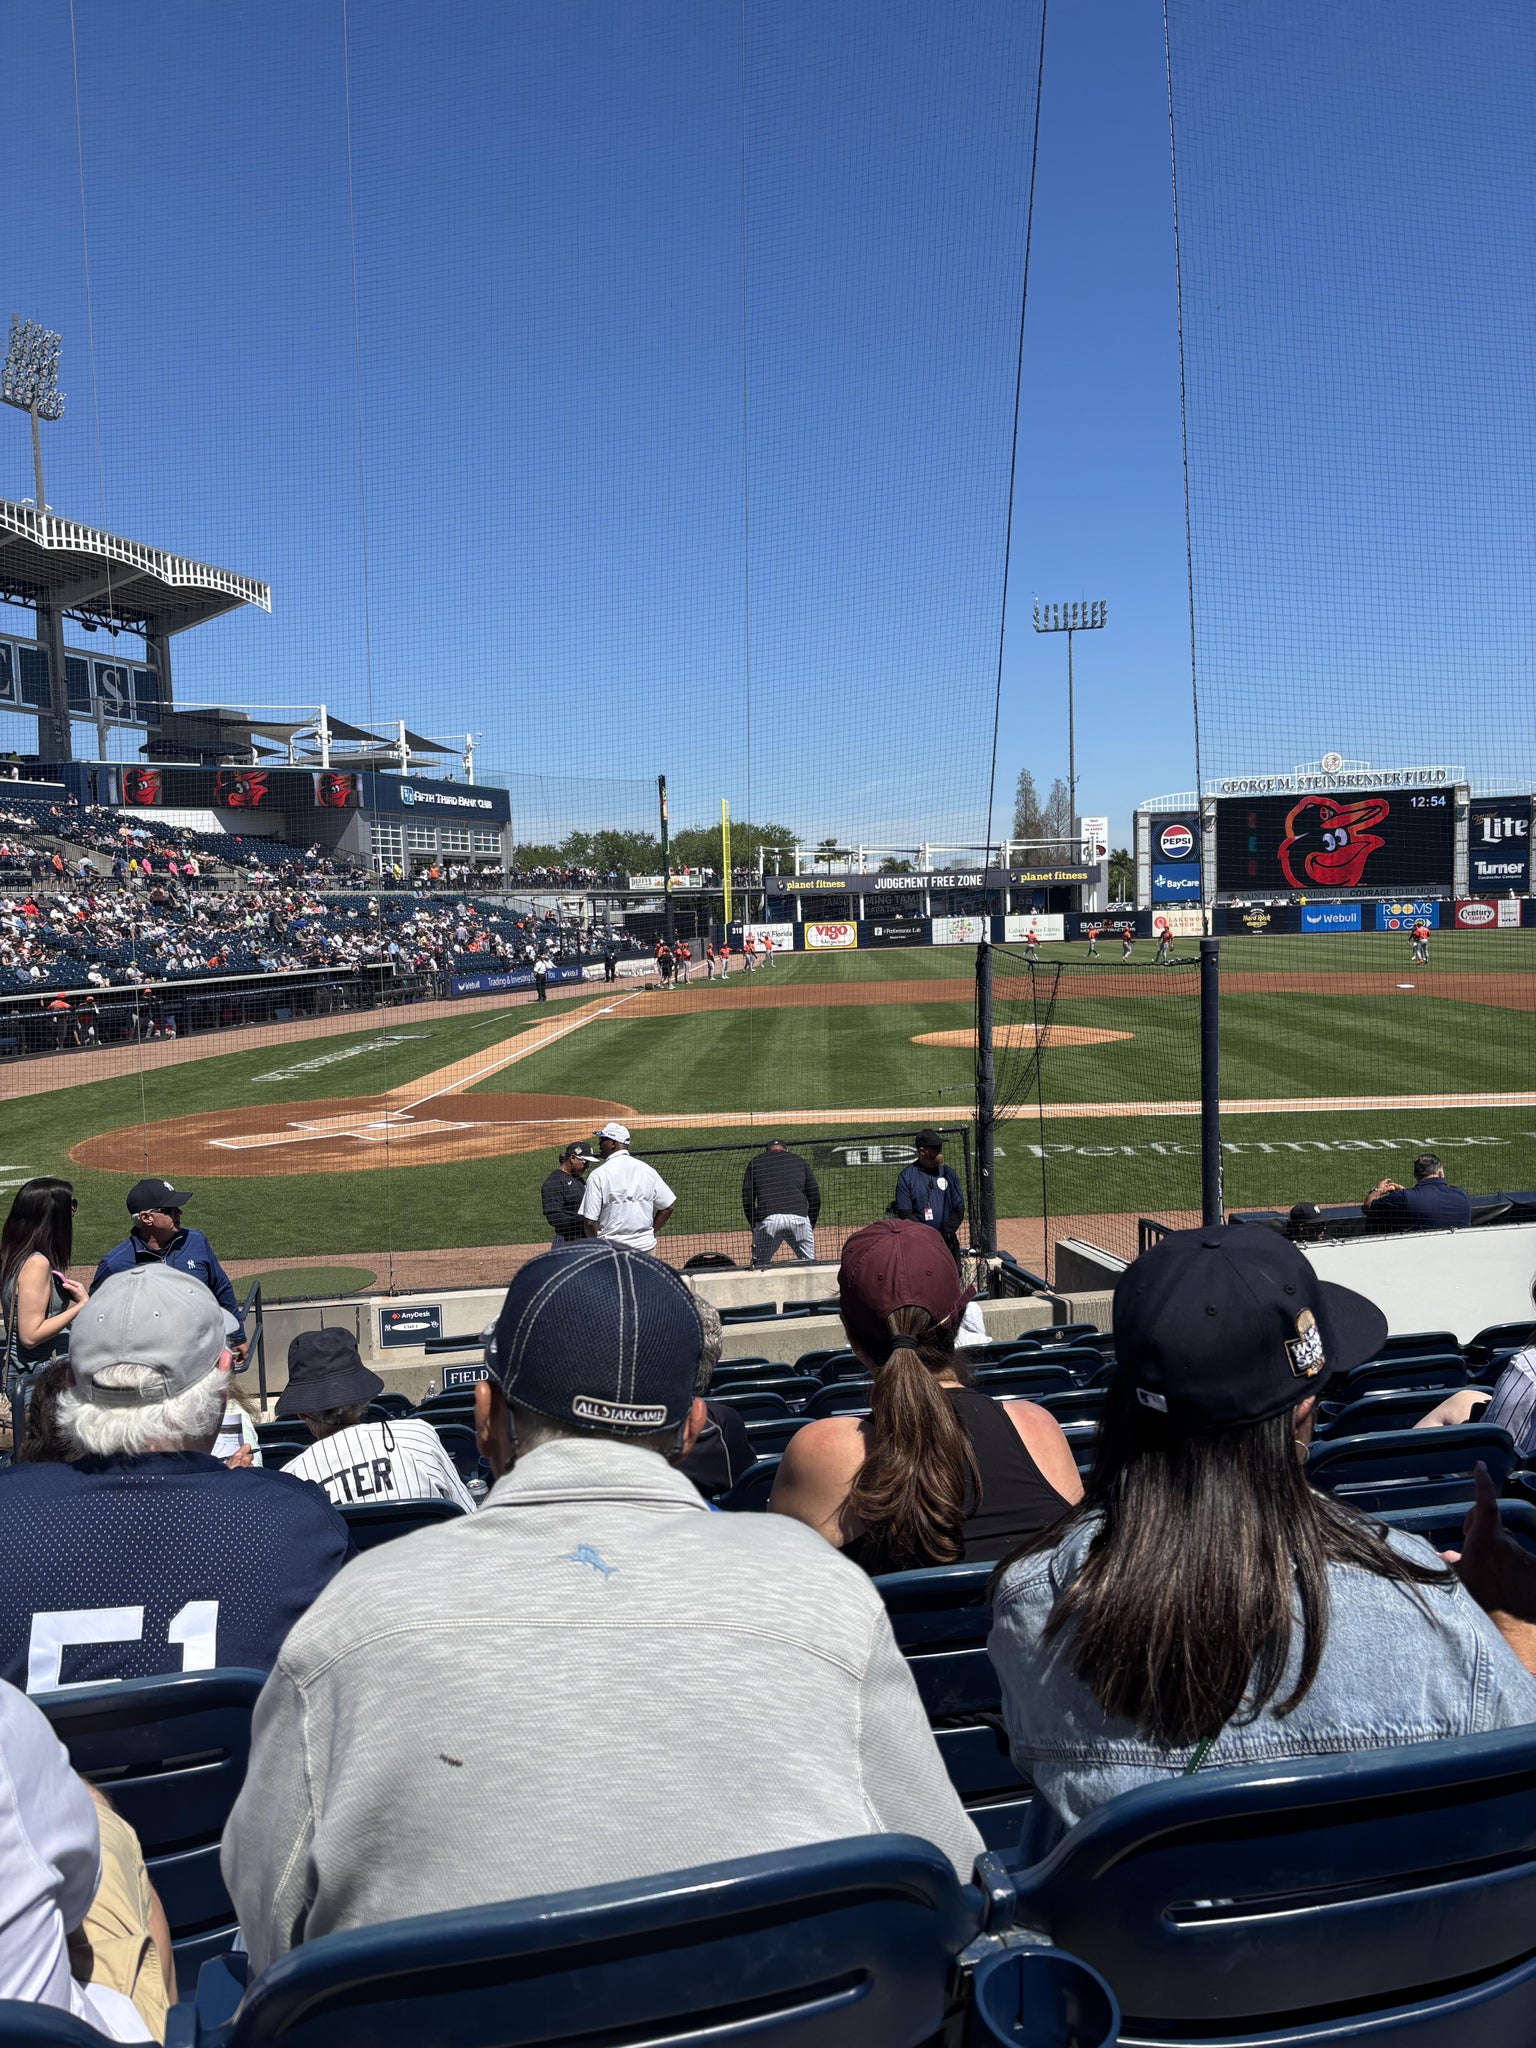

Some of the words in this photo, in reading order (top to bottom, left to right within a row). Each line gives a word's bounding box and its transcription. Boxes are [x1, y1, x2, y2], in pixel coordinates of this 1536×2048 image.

[1222, 778, 1275, 793] GEORGE
[1277, 777, 1294, 791] M.
[1299, 771, 1401, 790] STEINBRENNER
[1404, 769, 1446, 784] FIELD
[414, 791, 435, 803] FIFTH
[435, 794, 458, 806] THIRD
[458, 796, 478, 808] BANK
[477, 799, 493, 809] CLUB
[1410, 796, 1447, 808] 12:54
[1481, 817, 1528, 844] Lite
[1162, 837, 1191, 845] PEPSI
[1474, 861, 1525, 875] Turner
[874, 877, 928, 890] JUDGEMENT
[931, 876, 955, 888] FREE
[957, 874, 983, 887] ZONE
[1020, 873, 1052, 884] planet
[1054, 871, 1088, 881] fitness
[786, 880, 814, 891] planet
[815, 879, 846, 889] fitness
[1166, 879, 1200, 890] BayCare
[1350, 888, 1392, 897] COURAGE
[1394, 888, 1404, 896] TO
[1405, 887, 1416, 895] BE
[1417, 885, 1440, 895] MORE
[1383, 903, 1433, 915] ROOMS
[1461, 909, 1492, 920] Century
[1323, 914, 1357, 924] Webull
[1383, 918, 1401, 930] TO
[731, 927, 743, 935] 318
[771, 930, 792, 938] Florida
[488, 977, 506, 987] Trading
[511, 973, 530, 984] Investing
[401, 1311, 431, 1319] AnyDesk
[450, 1370, 489, 1384] FIELD
[317, 1457, 394, 1505] ETER
